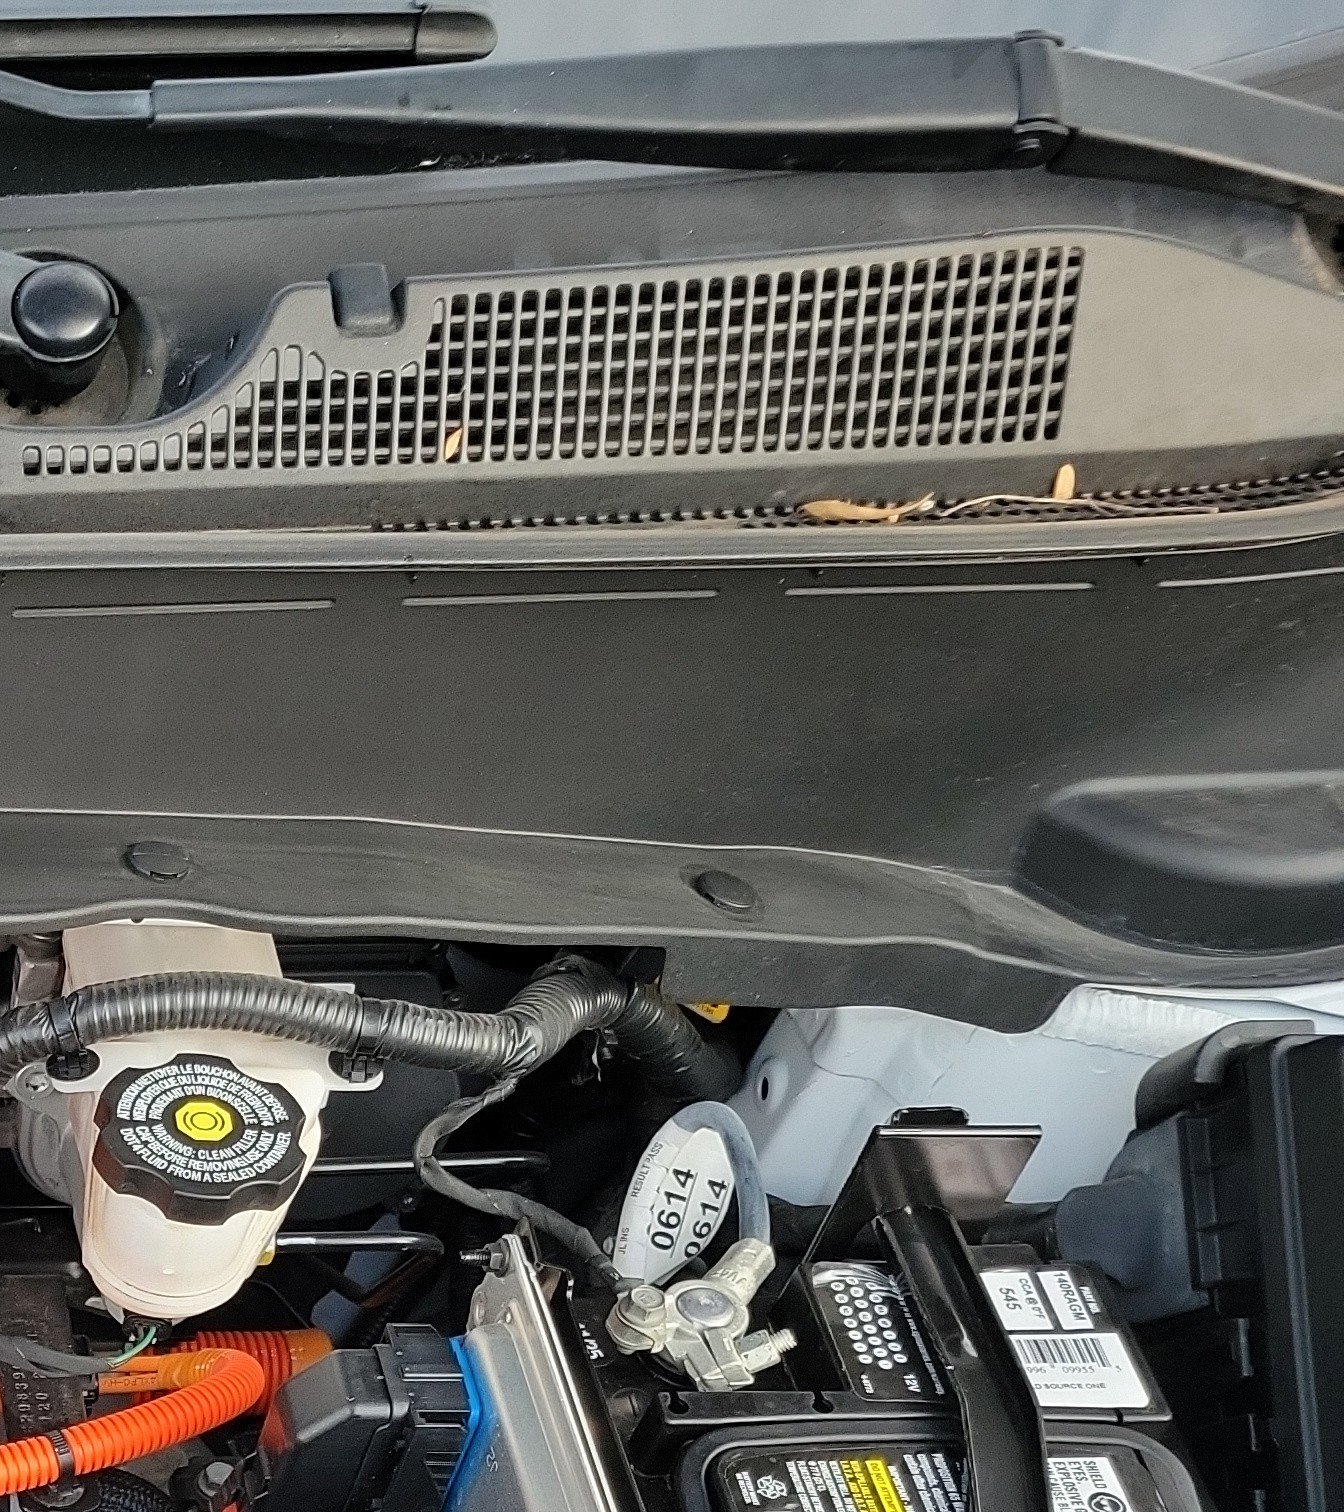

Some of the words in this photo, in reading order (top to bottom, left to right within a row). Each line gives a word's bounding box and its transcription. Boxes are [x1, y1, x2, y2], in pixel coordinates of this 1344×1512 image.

[179, 1076, 192, 1085] DU
[228, 1083, 240, 1094] DE
[180, 1064, 193, 1073] LE
[195, 1064, 239, 1083] BOUCHON
[239, 1076, 269, 1099] AVANT
[136, 1126, 156, 1145] CAP
[147, 1137, 187, 1166] BEFORE
[151, 1124, 196, 1159] WARNING:
[198, 1145, 232, 1160] CLEAN
[232, 1130, 258, 1155] FILLER
[136, 1149, 168, 1170] FLUID
[167, 1166, 201, 1182] FROM
[203, 1173, 212, 1182] A
[213, 1168, 255, 1183] SEALED
[629, 1163, 651, 1199] RESULT
[645, 1140, 663, 1164] PASS
[651, 1166, 696, 1251] 0614
[684, 1178, 727, 1258] 0614
[998, 1287, 1022, 1309] 545
[1018, 1278, 1034, 1294] CCA
[1053, 1272, 1086, 1320] 140RAGM
[901, 1373, 921, 1391] 12V
[869, 1463, 880, 1471] DO
[873, 1472, 886, 1484] NOT
[1052, 1462, 1082, 1501] EXPLOSIVE
[1067, 1461, 1090, 1484] EYES.
[1082, 1461, 1107, 1488] SHIELD
[877, 1485, 899, 1512] ATTEMPT
